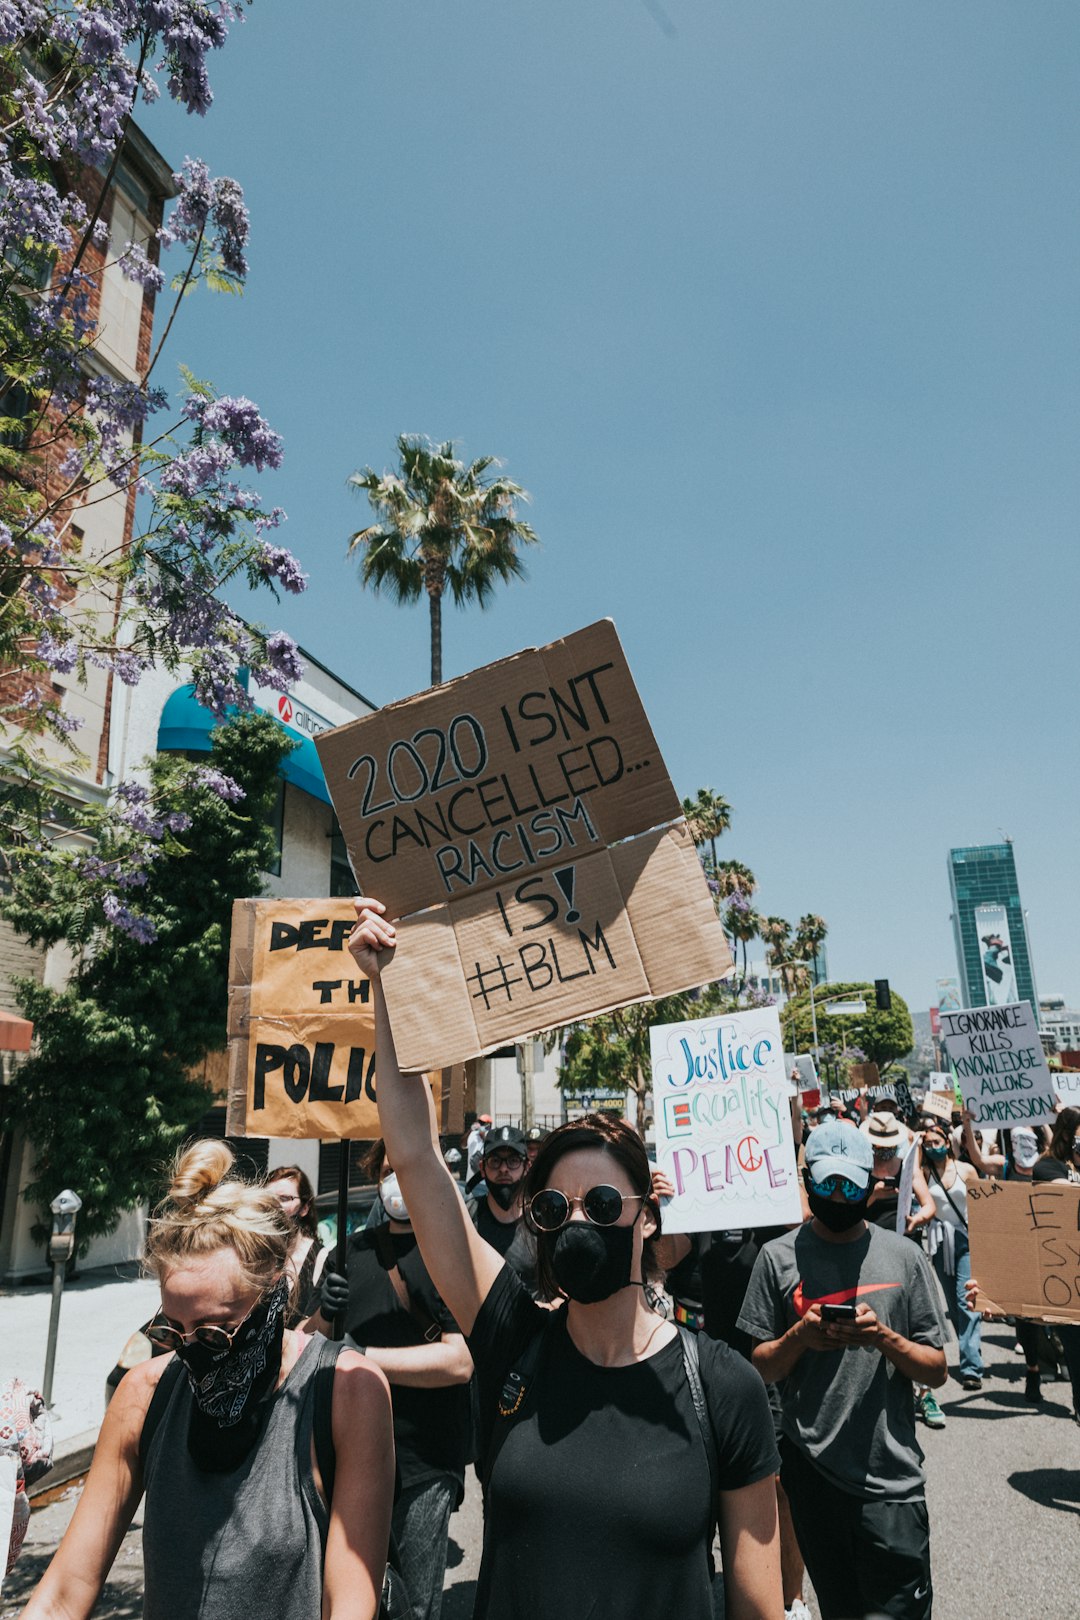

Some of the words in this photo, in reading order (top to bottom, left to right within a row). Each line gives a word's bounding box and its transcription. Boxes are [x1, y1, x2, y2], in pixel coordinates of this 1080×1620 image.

[295, 711, 325, 734] alltim
[347, 713, 488, 817] 2020
[500, 662, 613, 752] ISNT
[364, 735, 650, 863] CANCELLED...
[434, 798, 598, 892] RACISM
[495, 866, 581, 937] IS!
[269, 919, 357, 951] DEF
[467, 920, 616, 1010] #BLM
[312, 979, 370, 1004] TH
[940, 1006, 1027, 1037] IGNORANCE
[968, 1032, 1013, 1054] KILLS
[254, 1042, 377, 1110] POLI
[951, 1048, 1042, 1078] KNOWLEDGE
[981, 1072, 1033, 1096] ALLOWS
[966, 1094, 1055, 1123] COMPASSION
[831, 1138, 849, 1155] ck
[967, 1183, 1003, 1200] BLM
[1026, 1192, 1080, 1232] E
